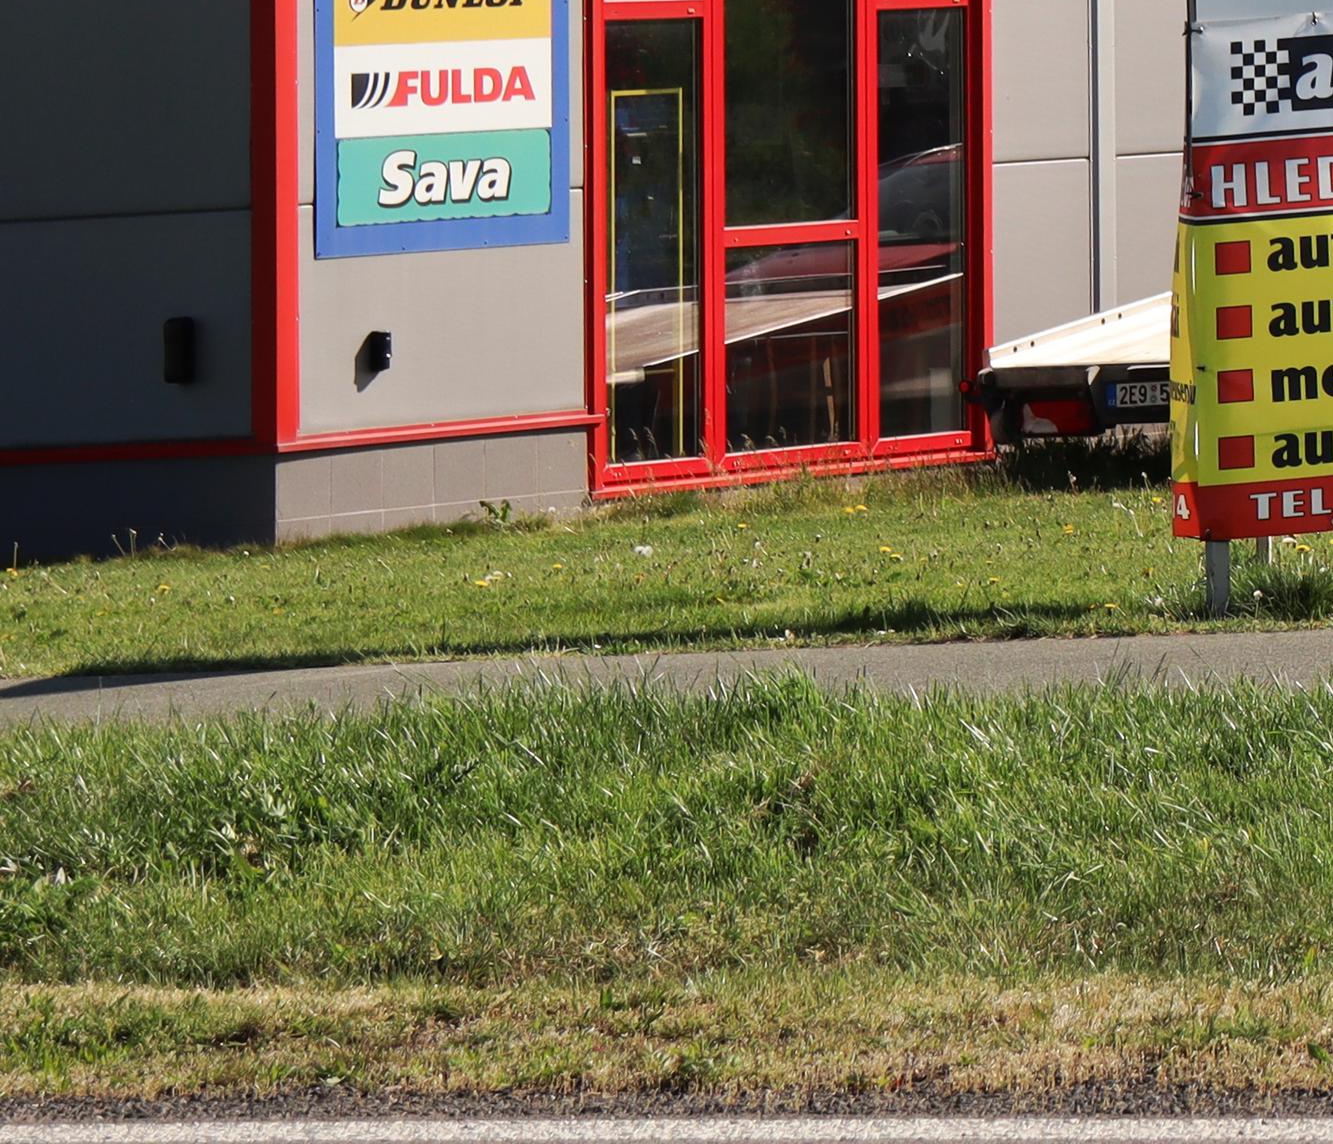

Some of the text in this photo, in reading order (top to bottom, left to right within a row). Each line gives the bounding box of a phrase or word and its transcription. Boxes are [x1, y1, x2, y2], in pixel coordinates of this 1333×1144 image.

[387, 66, 536, 108] FULDA
[378, 149, 513, 208] Sava
[1119, 384, 1147, 405] 2E9
